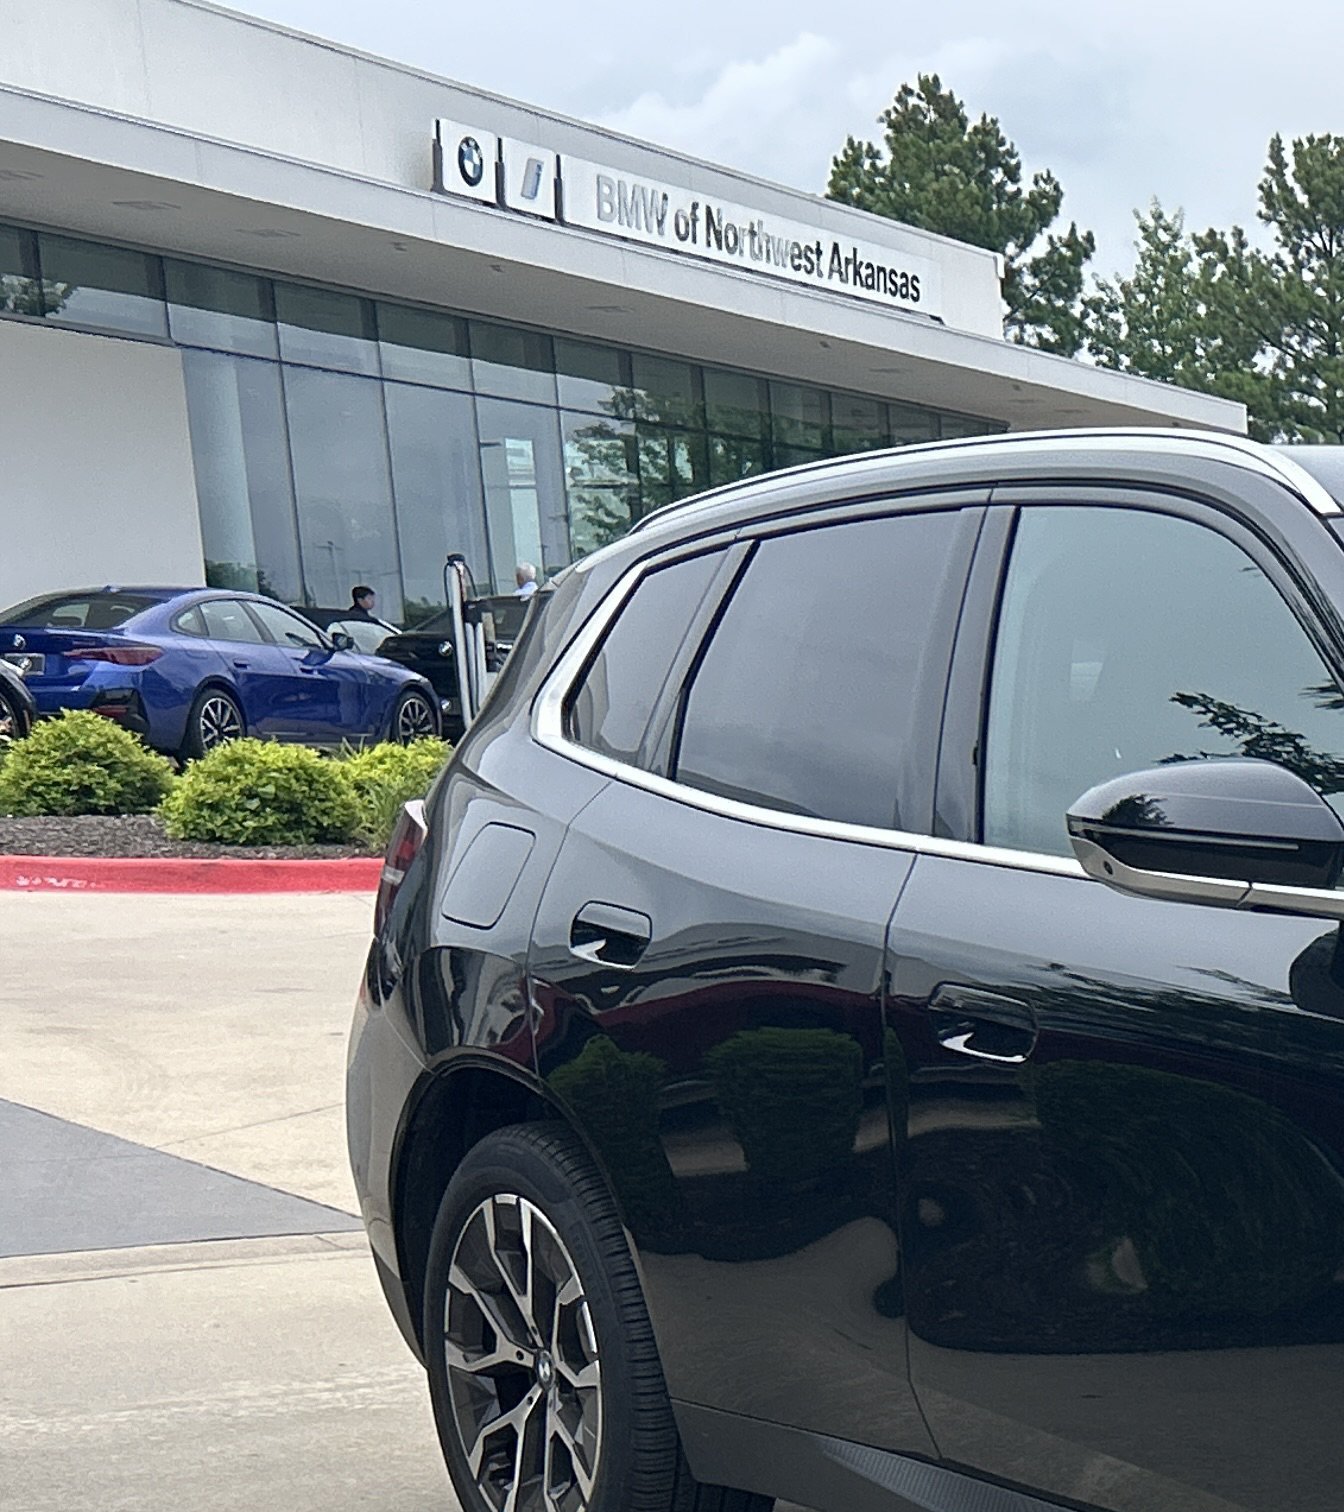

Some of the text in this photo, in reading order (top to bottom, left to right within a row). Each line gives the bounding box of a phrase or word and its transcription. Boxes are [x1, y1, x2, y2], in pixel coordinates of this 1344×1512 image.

[596, 174, 921, 303] BMW of Northwest Arkansas
